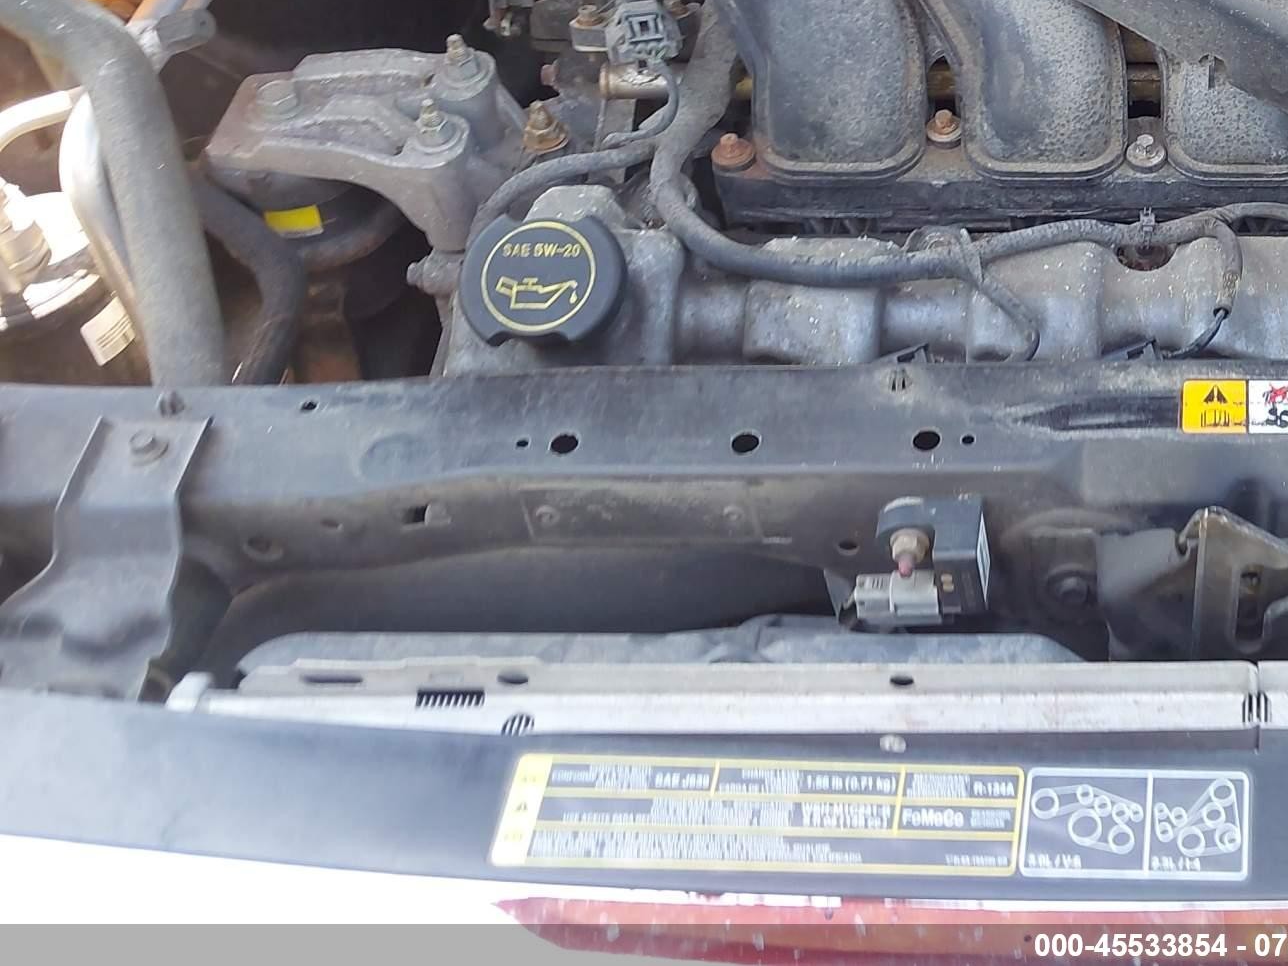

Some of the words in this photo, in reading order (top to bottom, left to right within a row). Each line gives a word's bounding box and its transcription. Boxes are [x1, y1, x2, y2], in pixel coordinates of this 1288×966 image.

[502, 243, 530, 257] SAE
[533, 242, 581, 257] 5W-20
[902, 808, 964, 828] FoMoCo
